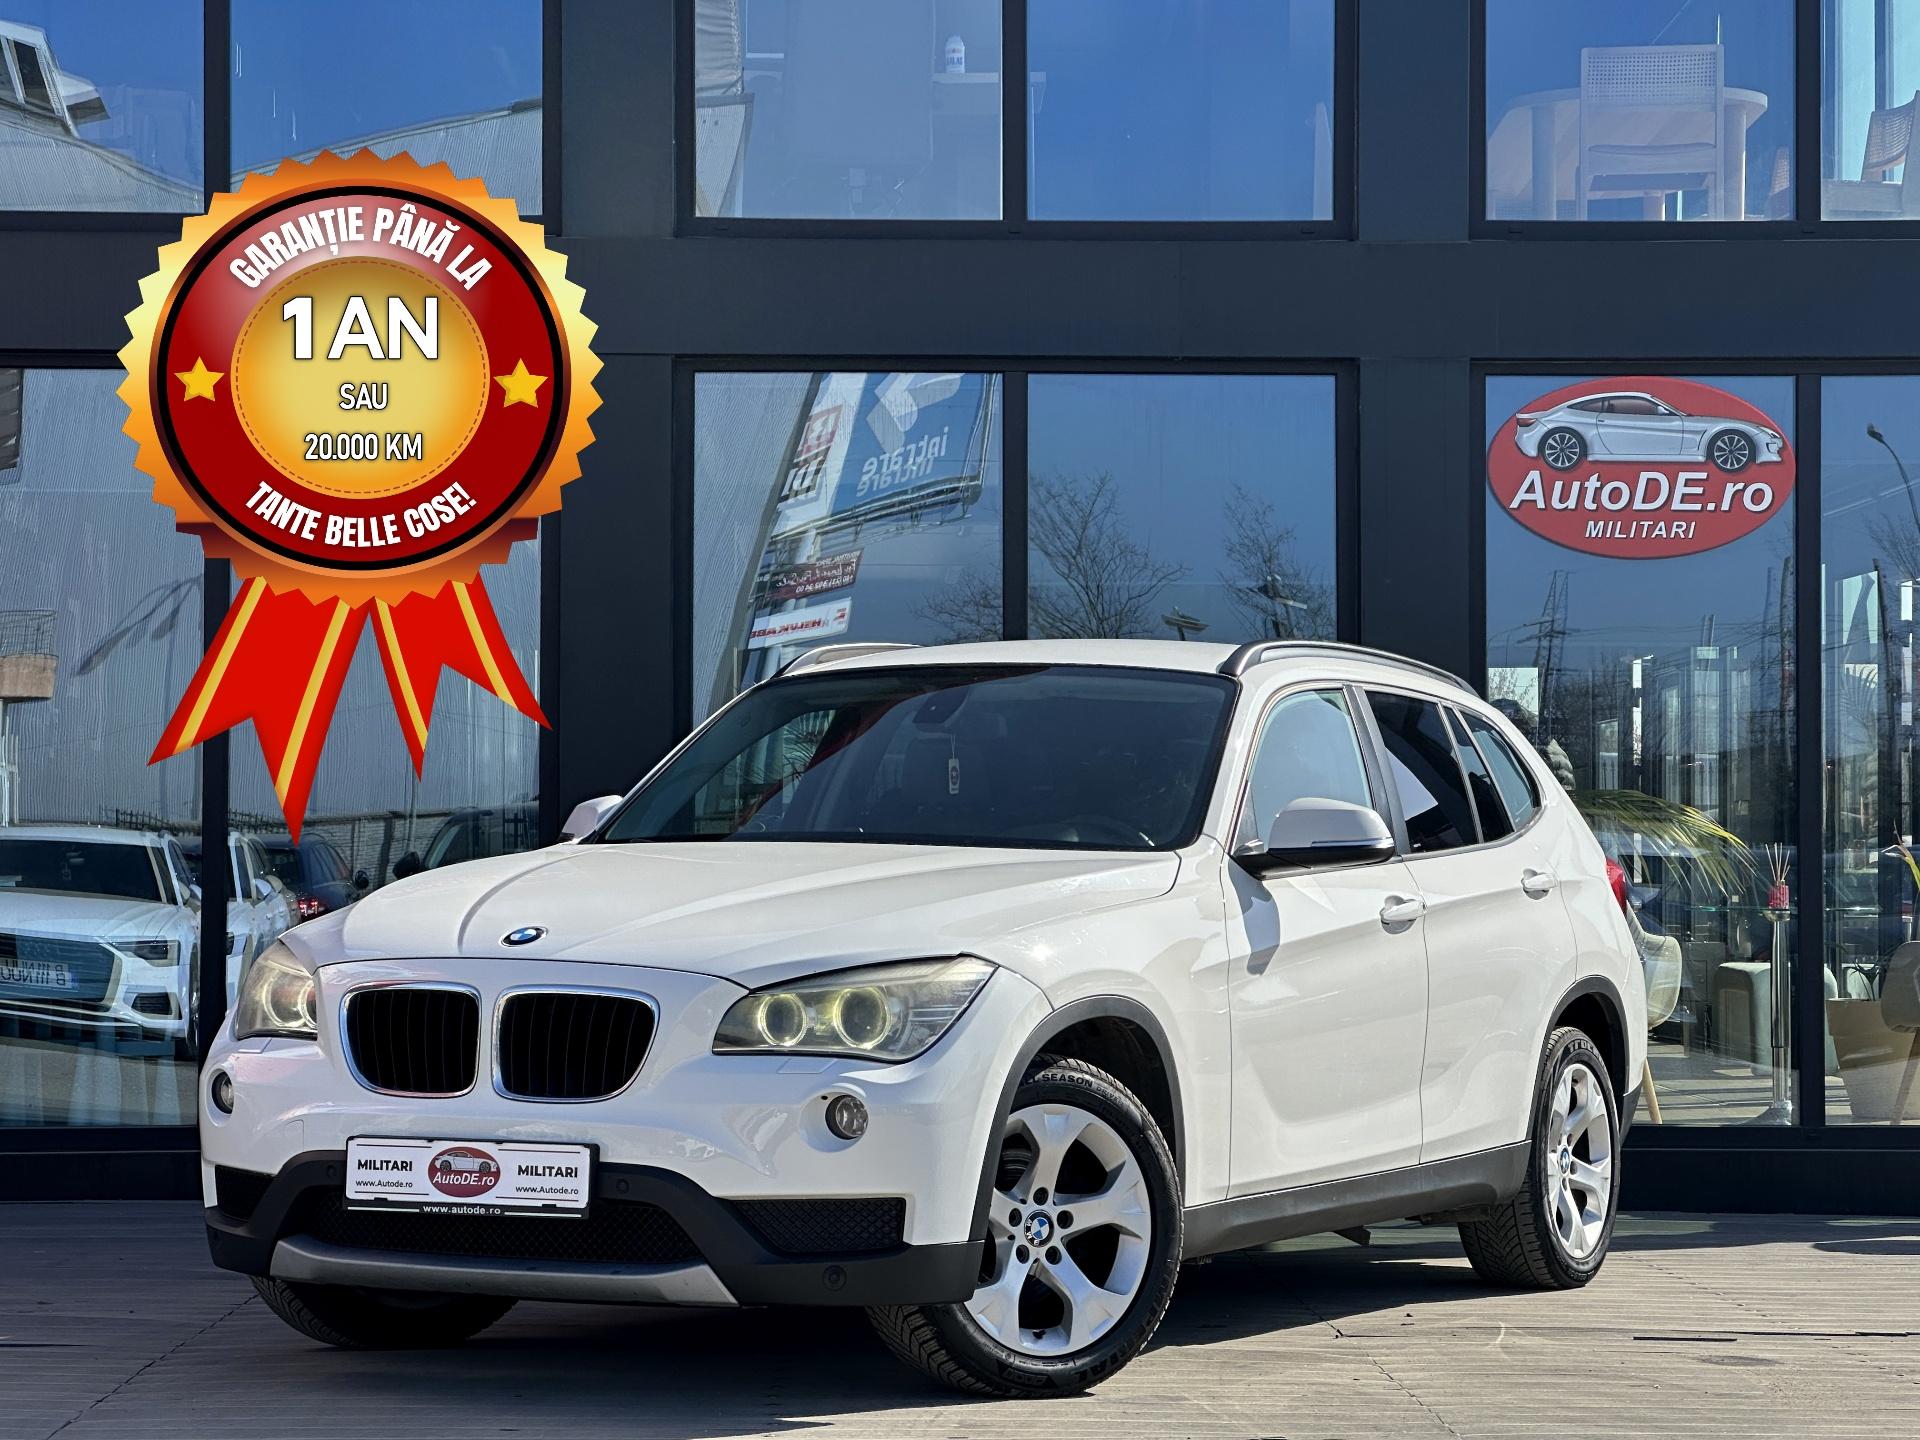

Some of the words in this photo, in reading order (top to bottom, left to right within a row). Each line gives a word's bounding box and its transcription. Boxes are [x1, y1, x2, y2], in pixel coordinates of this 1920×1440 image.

[1509, 470, 1774, 512] AutoDE.ro
[1584, 520, 1697, 539] MILITARI
[1041, 1073, 1093, 1088] SEASON
[357, 1159, 413, 1172] MILITARI
[517, 1164, 578, 1178] MILITARI
[355, 1179, 413, 1188] www.Autode.ro
[432, 1172, 495, 1186] AutoDE.ro
[515, 1185, 579, 1195] www.Autode.ro
[423, 1205, 501, 1215] www.autode.ro
